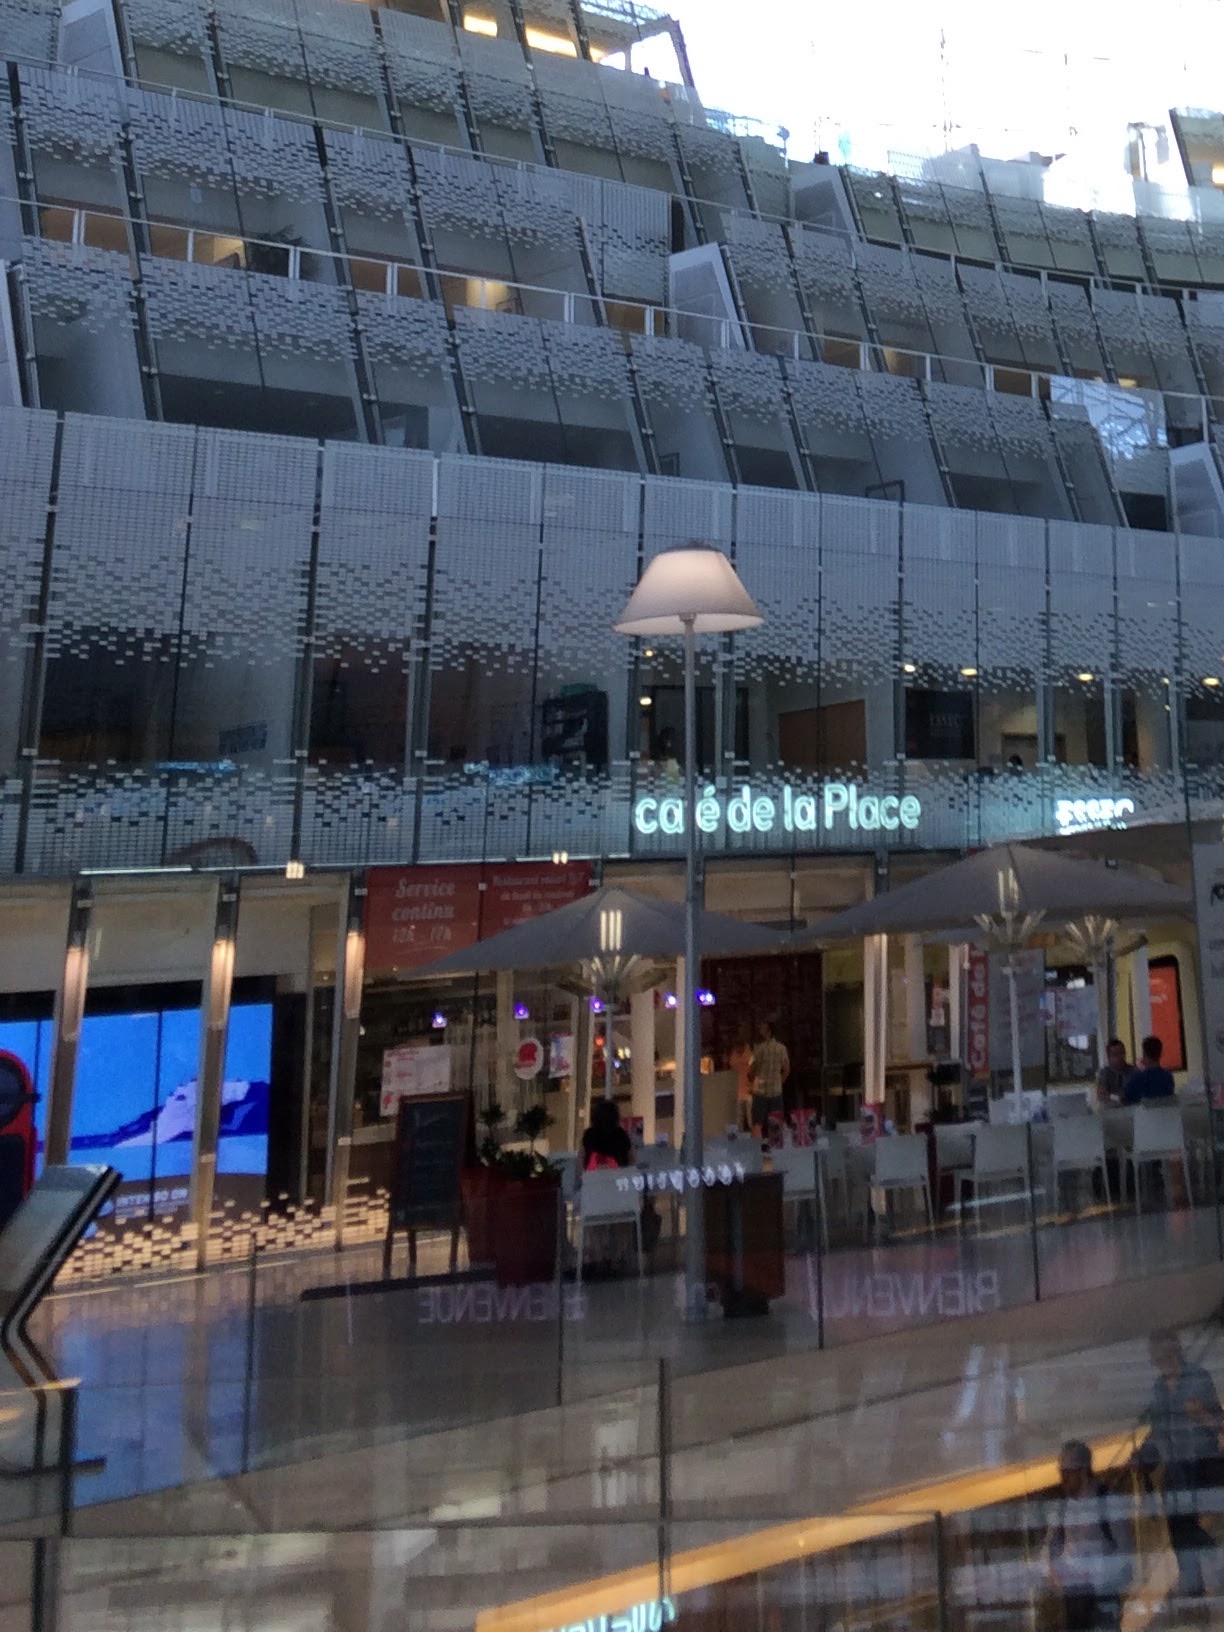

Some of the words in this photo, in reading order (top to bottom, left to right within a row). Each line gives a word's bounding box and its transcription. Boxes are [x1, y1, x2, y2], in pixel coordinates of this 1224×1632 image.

[727, 784, 775, 832] de
[783, 784, 817, 831] la
[824, 783, 922, 831] Place
[395, 878, 456, 898] Service
[392, 902, 455, 922] continu
